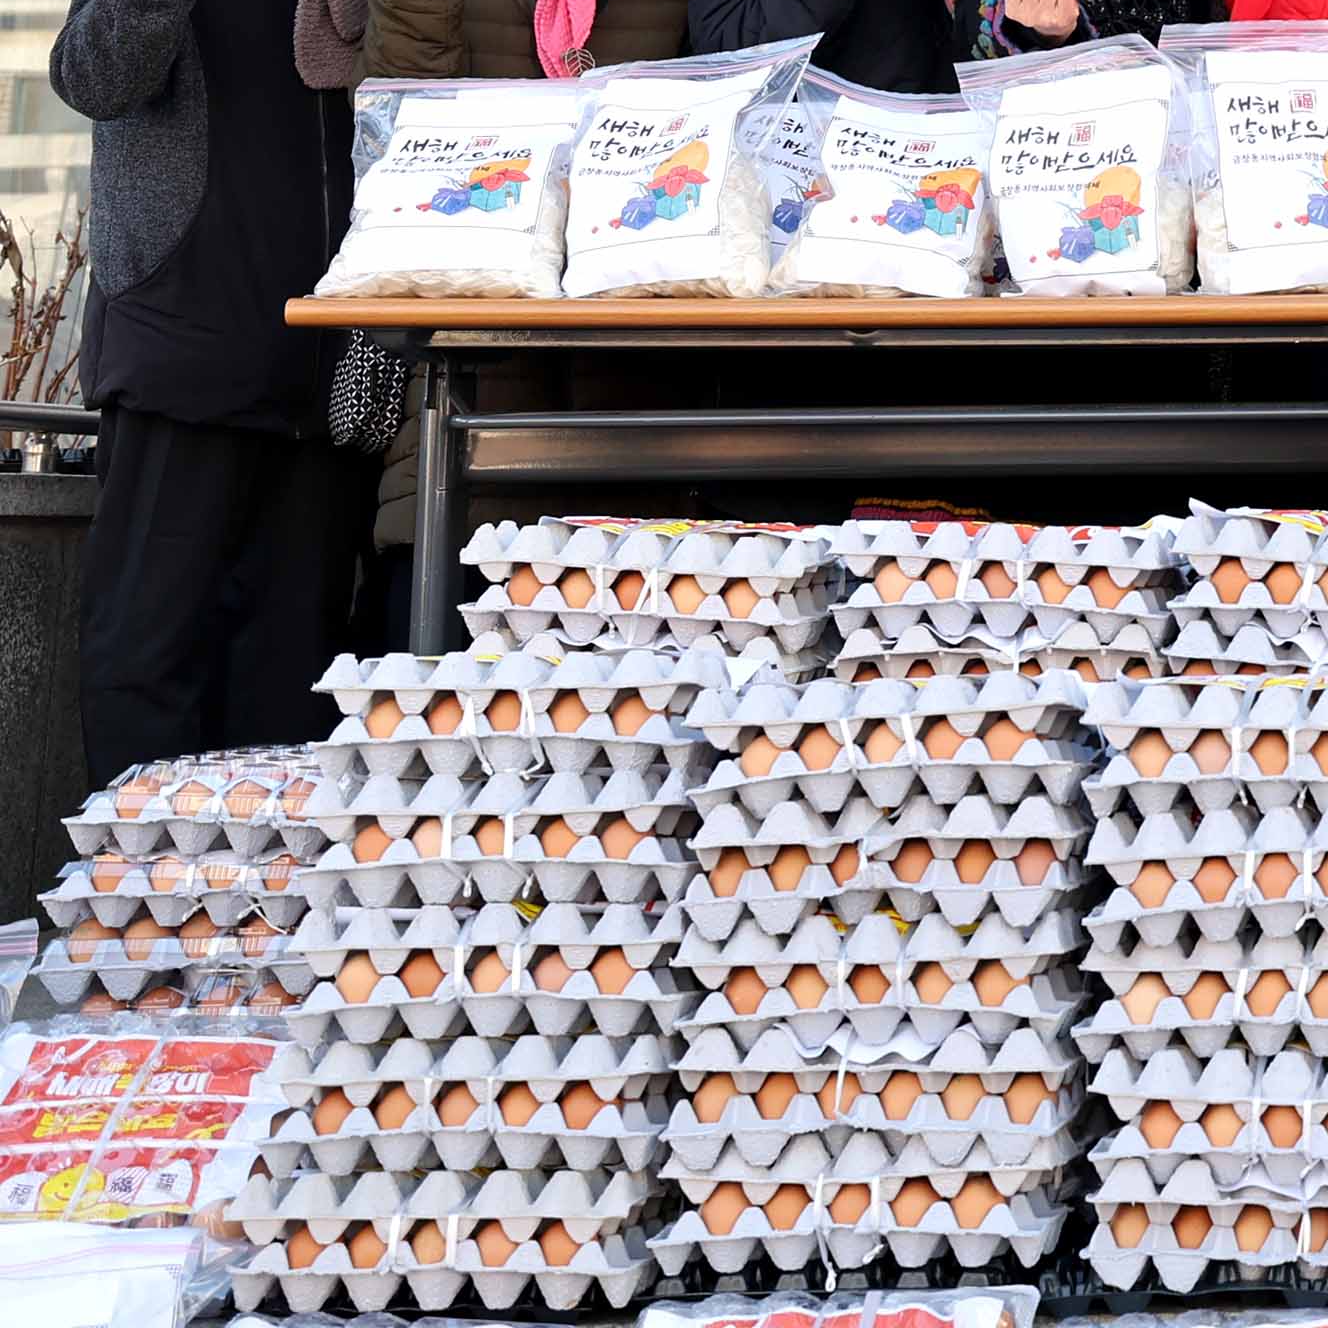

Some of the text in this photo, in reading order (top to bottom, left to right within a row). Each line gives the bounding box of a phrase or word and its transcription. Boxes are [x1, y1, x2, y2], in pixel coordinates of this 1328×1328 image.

[1227, 96, 1279, 114] 새해
[598, 118, 654, 137] 새해
[1005, 126, 1060, 144] 새해
